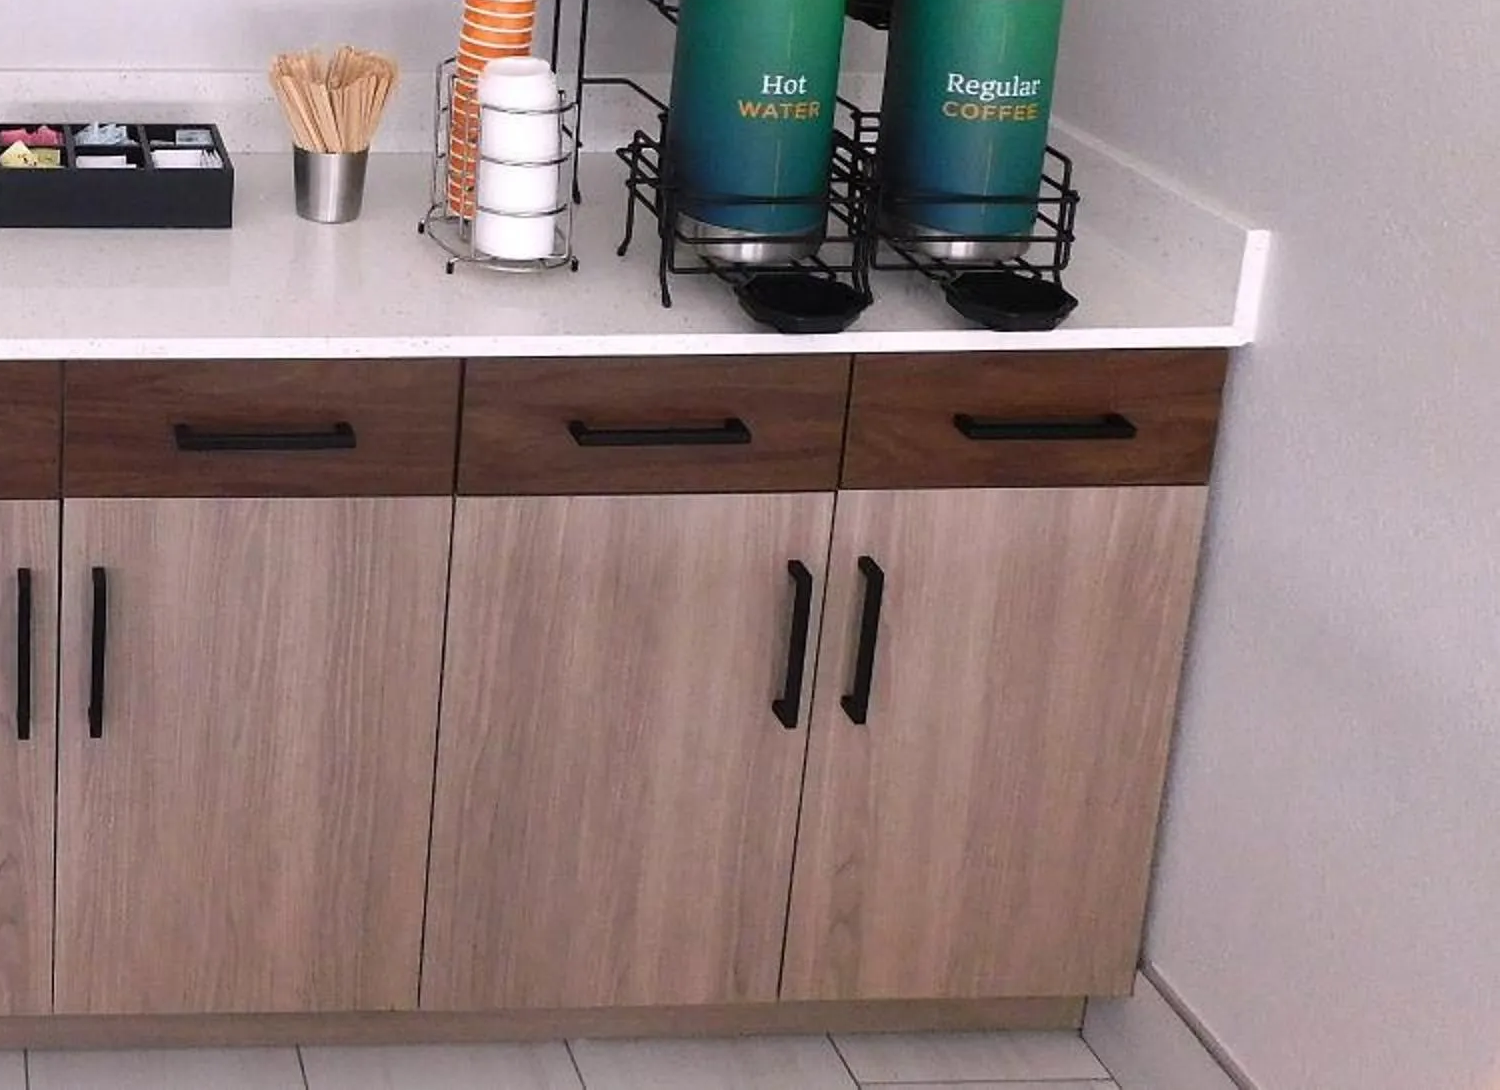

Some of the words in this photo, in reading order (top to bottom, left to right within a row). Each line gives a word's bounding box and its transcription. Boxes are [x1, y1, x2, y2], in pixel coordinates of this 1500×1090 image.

[761, 74, 807, 96] Hot
[946, 73, 1041, 102] Regular
[737, 99, 821, 119] WATER
[942, 100, 1038, 122] COFFEE
